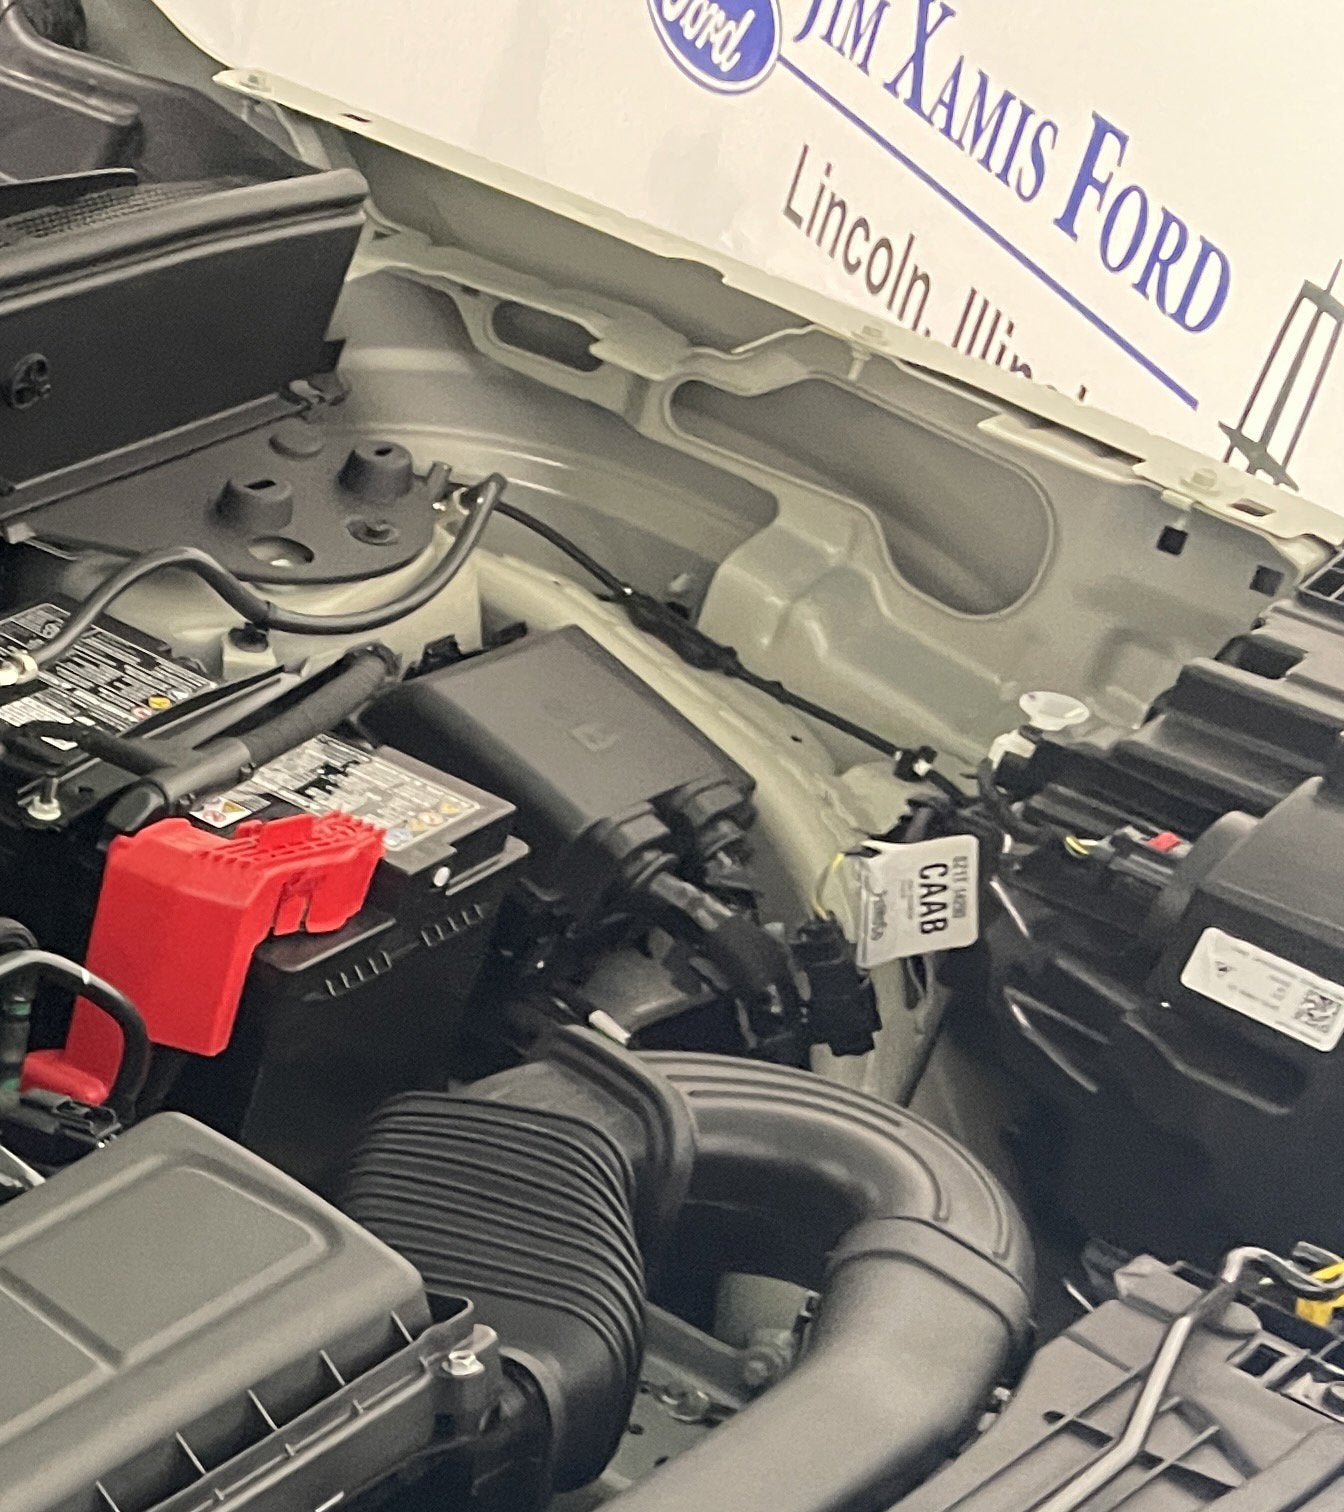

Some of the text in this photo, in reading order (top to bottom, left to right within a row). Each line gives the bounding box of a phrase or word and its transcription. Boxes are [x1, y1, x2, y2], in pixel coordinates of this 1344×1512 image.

[883, 0, 1058, 202] XAMIS
[1053, 110, 1231, 333] FORD
[919, 863, 949, 935] CAAB
